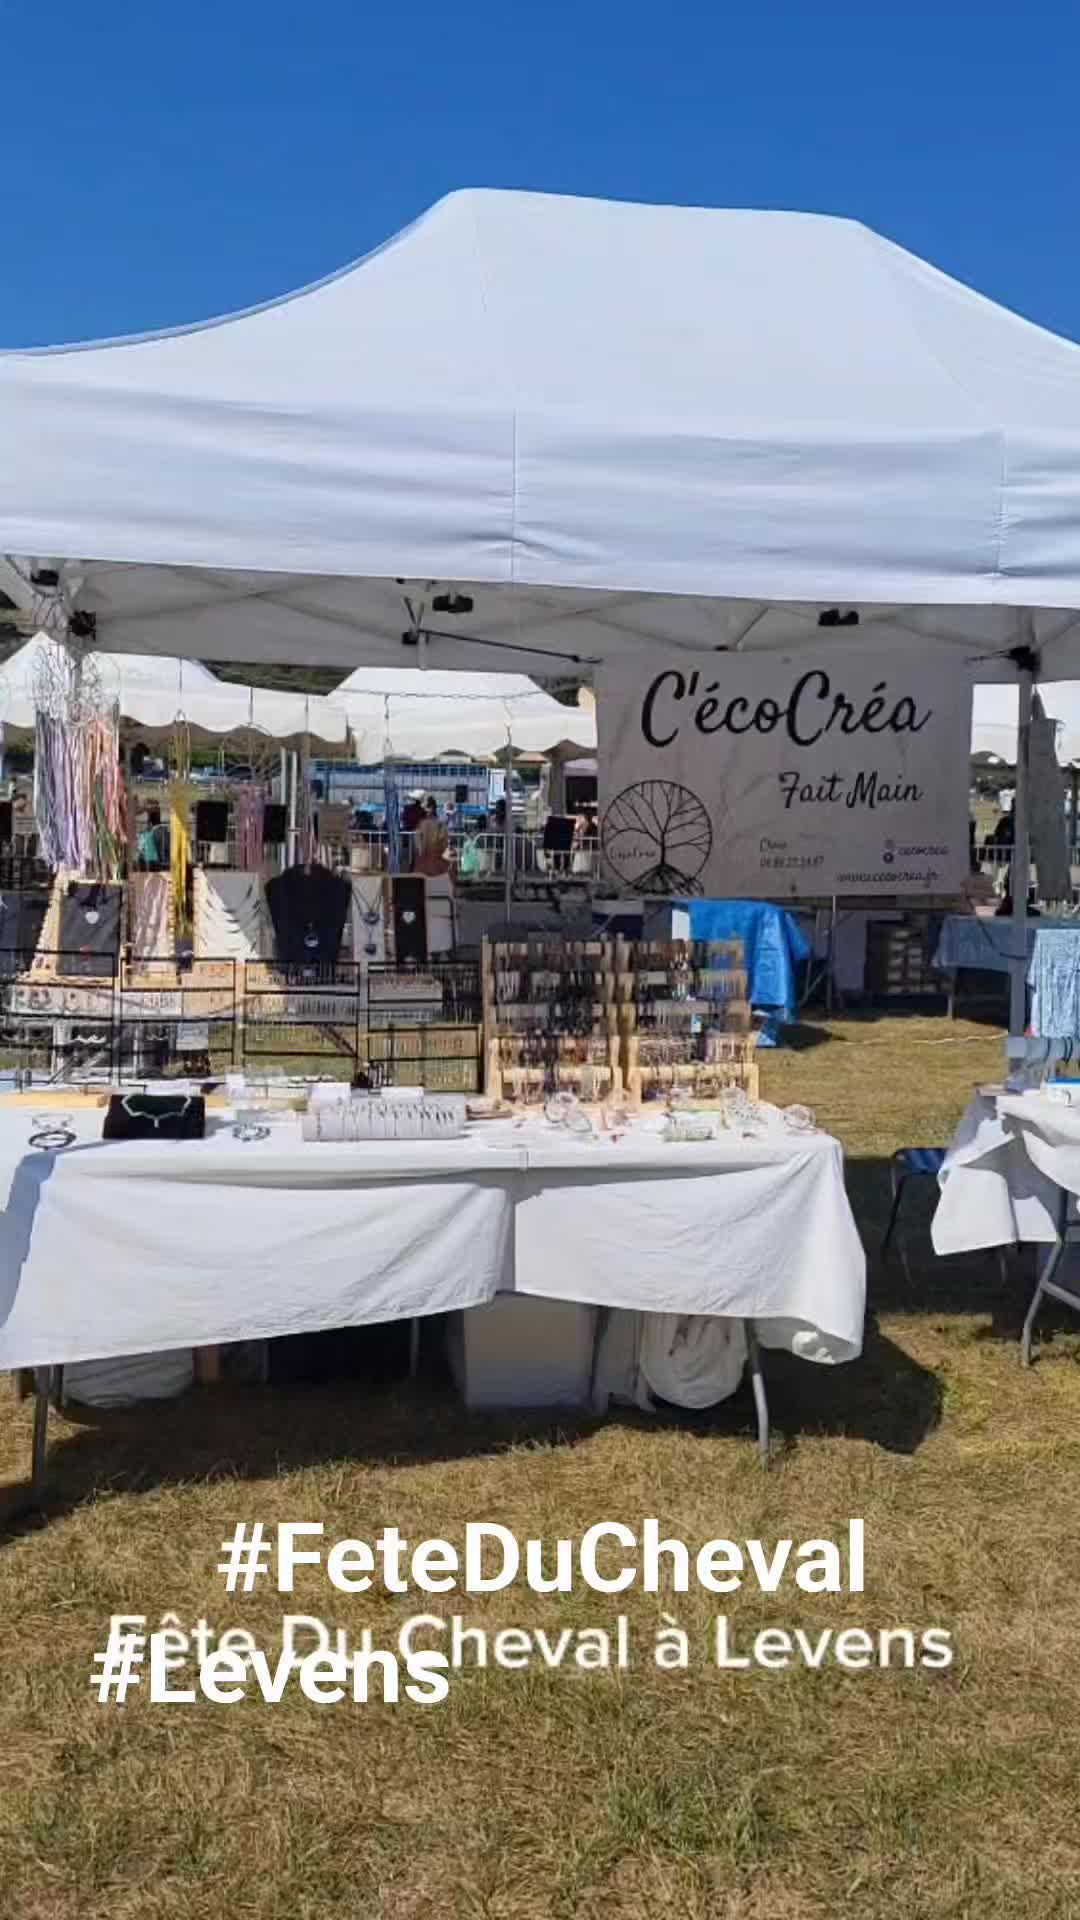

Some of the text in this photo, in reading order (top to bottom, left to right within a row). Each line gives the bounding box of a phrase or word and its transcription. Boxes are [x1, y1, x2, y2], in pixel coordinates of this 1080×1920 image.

[641, 670, 933, 747] C'écoCréa
[779, 771, 924, 808] Fait Main
